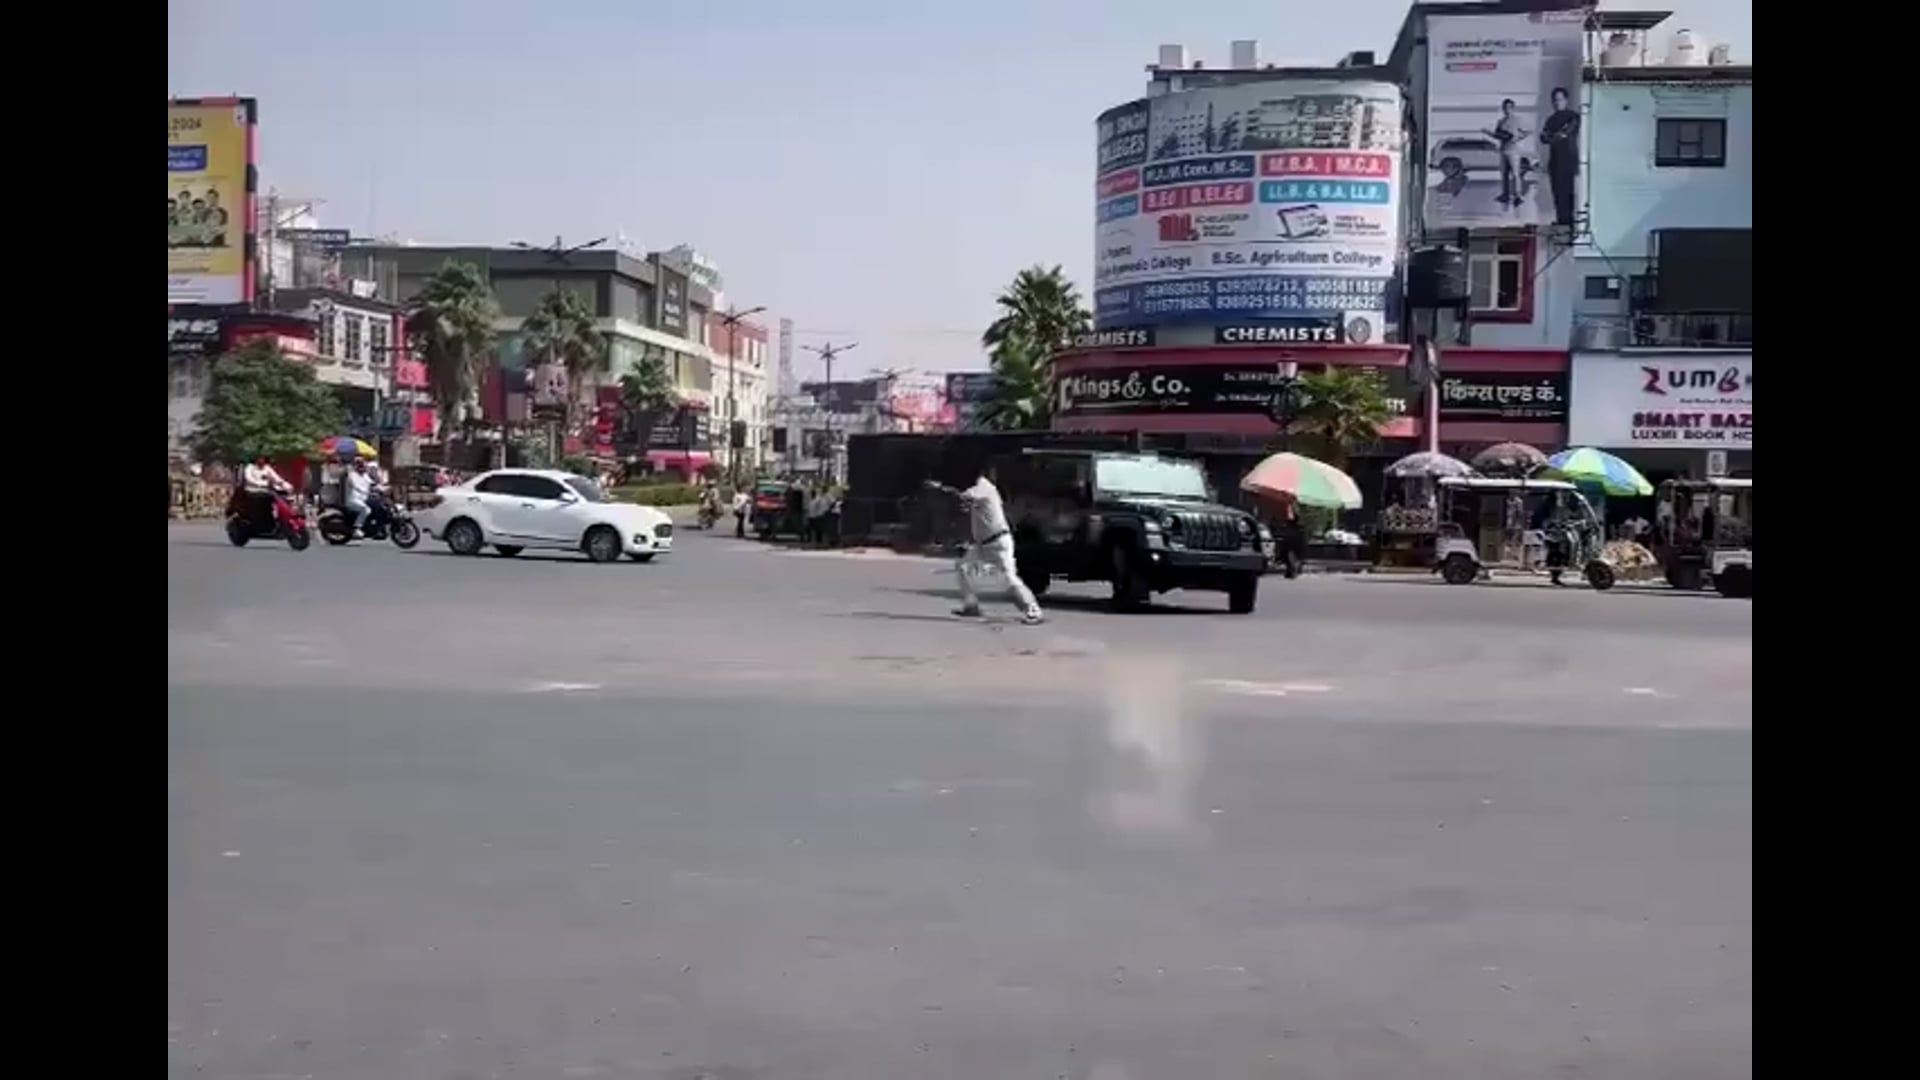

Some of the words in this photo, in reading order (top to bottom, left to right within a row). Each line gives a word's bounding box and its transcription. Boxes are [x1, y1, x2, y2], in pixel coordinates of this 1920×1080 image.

[1269, 155, 1318, 172] M.B.A.
[1336, 155, 1383, 174] M.C.A.
[1250, 250, 1329, 266] Agriculture
[1333, 251, 1382, 267] College
[1223, 327, 1336, 341] CHEMISTS
[1070, 375, 1121, 399] Kings
[1121, 370, 1146, 399] &
[1151, 375, 1191, 394] Co.
[1633, 413, 1705, 428] SMART
[1711, 413, 1752, 428] BAZ
[1632, 429, 1677, 440] LUXMI
[1683, 430, 1725, 440] BOOK
